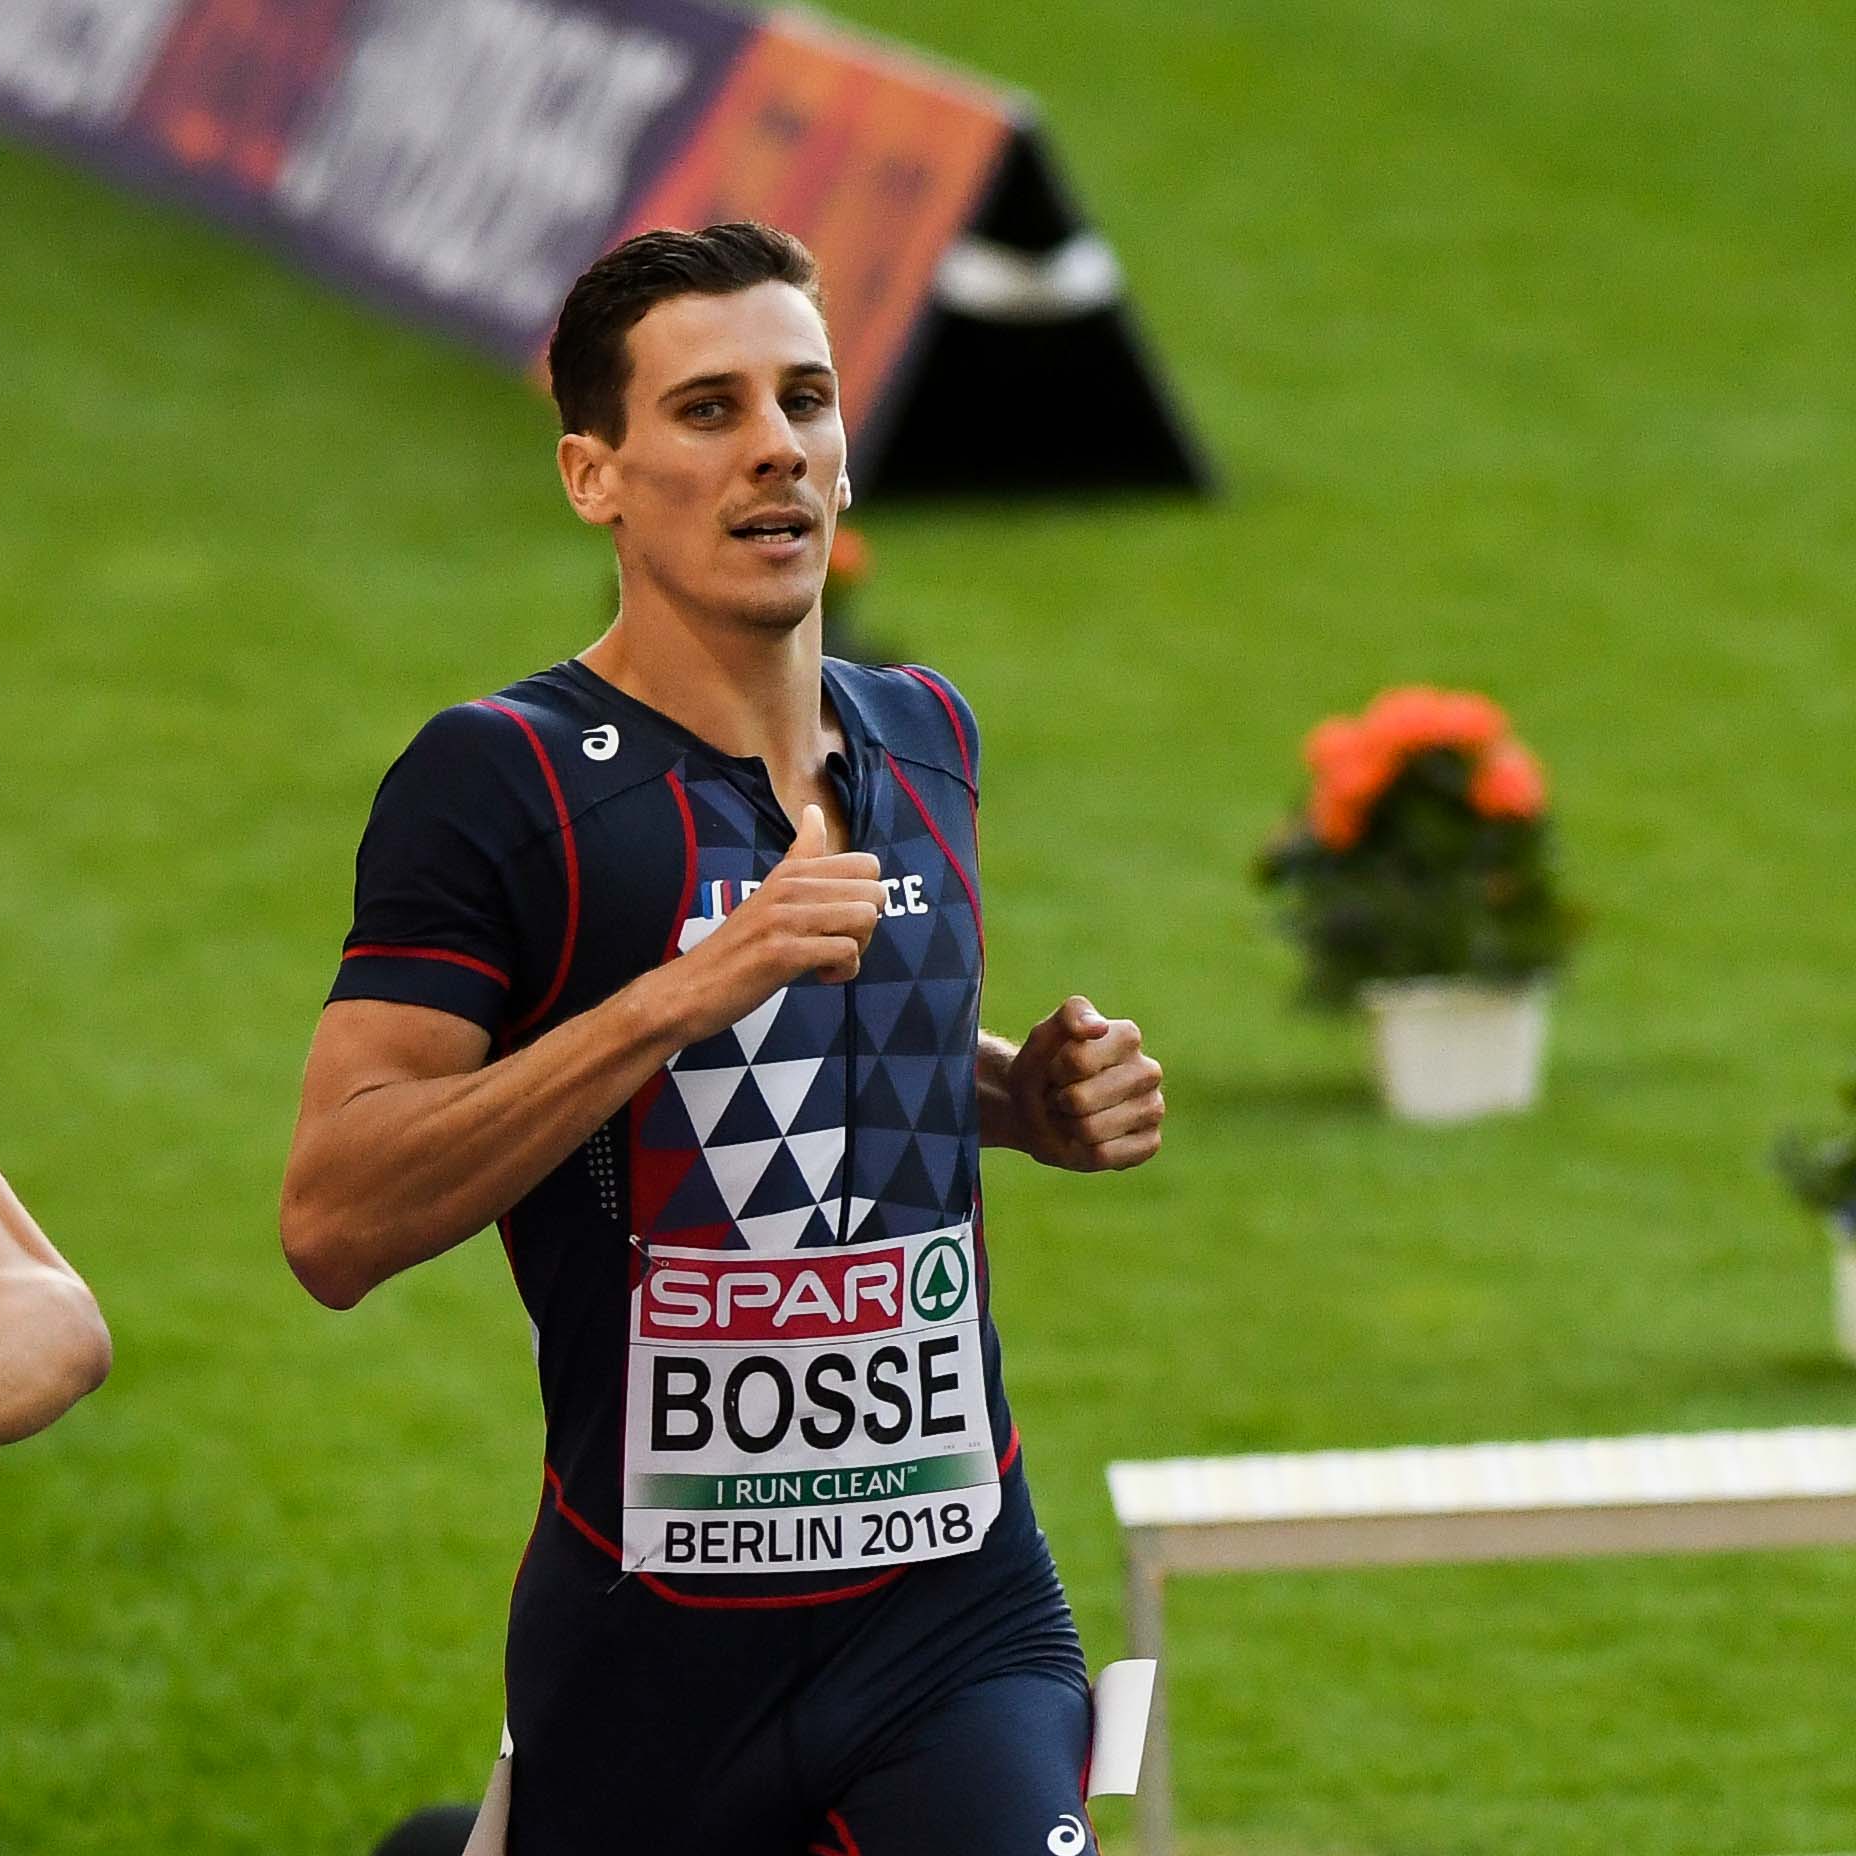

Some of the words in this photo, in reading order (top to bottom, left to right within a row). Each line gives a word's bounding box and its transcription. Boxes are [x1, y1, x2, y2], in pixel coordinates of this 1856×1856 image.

[650, 1261, 897, 1328] SPAR
[650, 1335, 967, 1454] BOSSE
[716, 1480, 725, 1504] I
[736, 1477, 801, 1503] RUN
[664, 1516, 843, 1563] BERLIN
[861, 1503, 973, 1549] 2018
